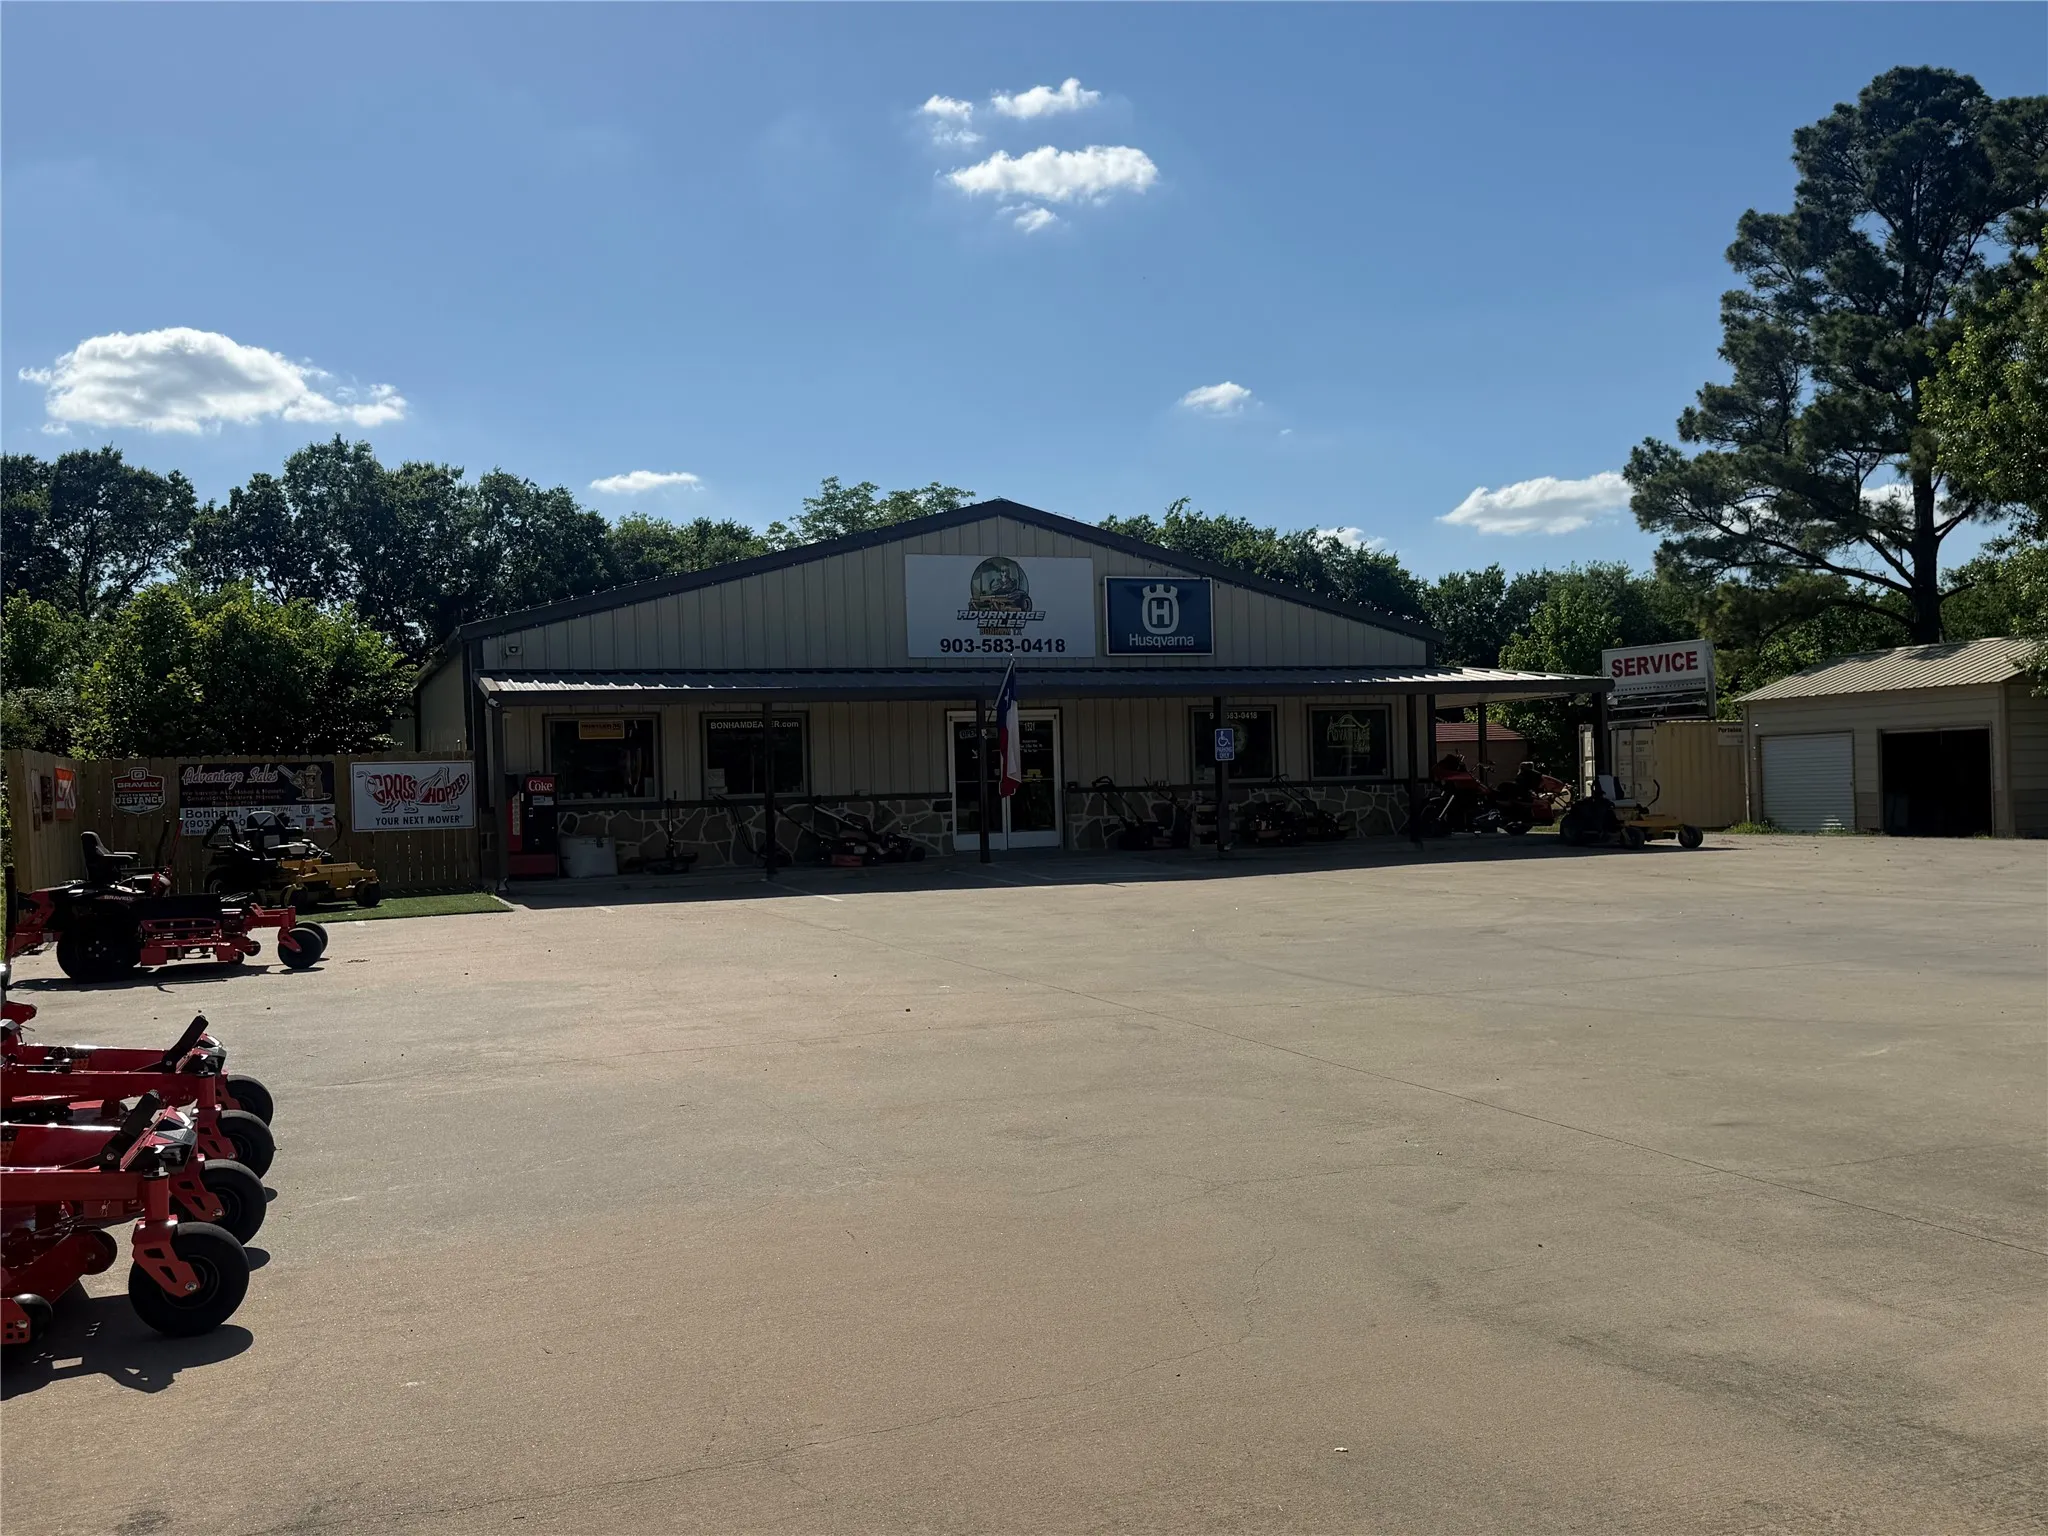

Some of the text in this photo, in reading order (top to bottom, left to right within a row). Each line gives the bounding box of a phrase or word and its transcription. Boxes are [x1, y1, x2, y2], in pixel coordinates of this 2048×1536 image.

[957, 610, 1046, 621] ADVANTAGE
[977, 619, 1027, 628] SALES
[940, 638, 1066, 653] 903-583-0418
[1128, 633, 1195, 648] Husqvarna
[1611, 651, 1699, 678] SERVICE
[182, 763, 279, 790] Advantage Sales
[117, 781, 160, 789] GRAVELY
[528, 779, 554, 792] Coke
[115, 796, 164, 805] DISTANCE
[270, 806, 292, 814] STIHL
[375, 817, 399, 826] YOUR
[403, 816, 424, 825] NEXT
